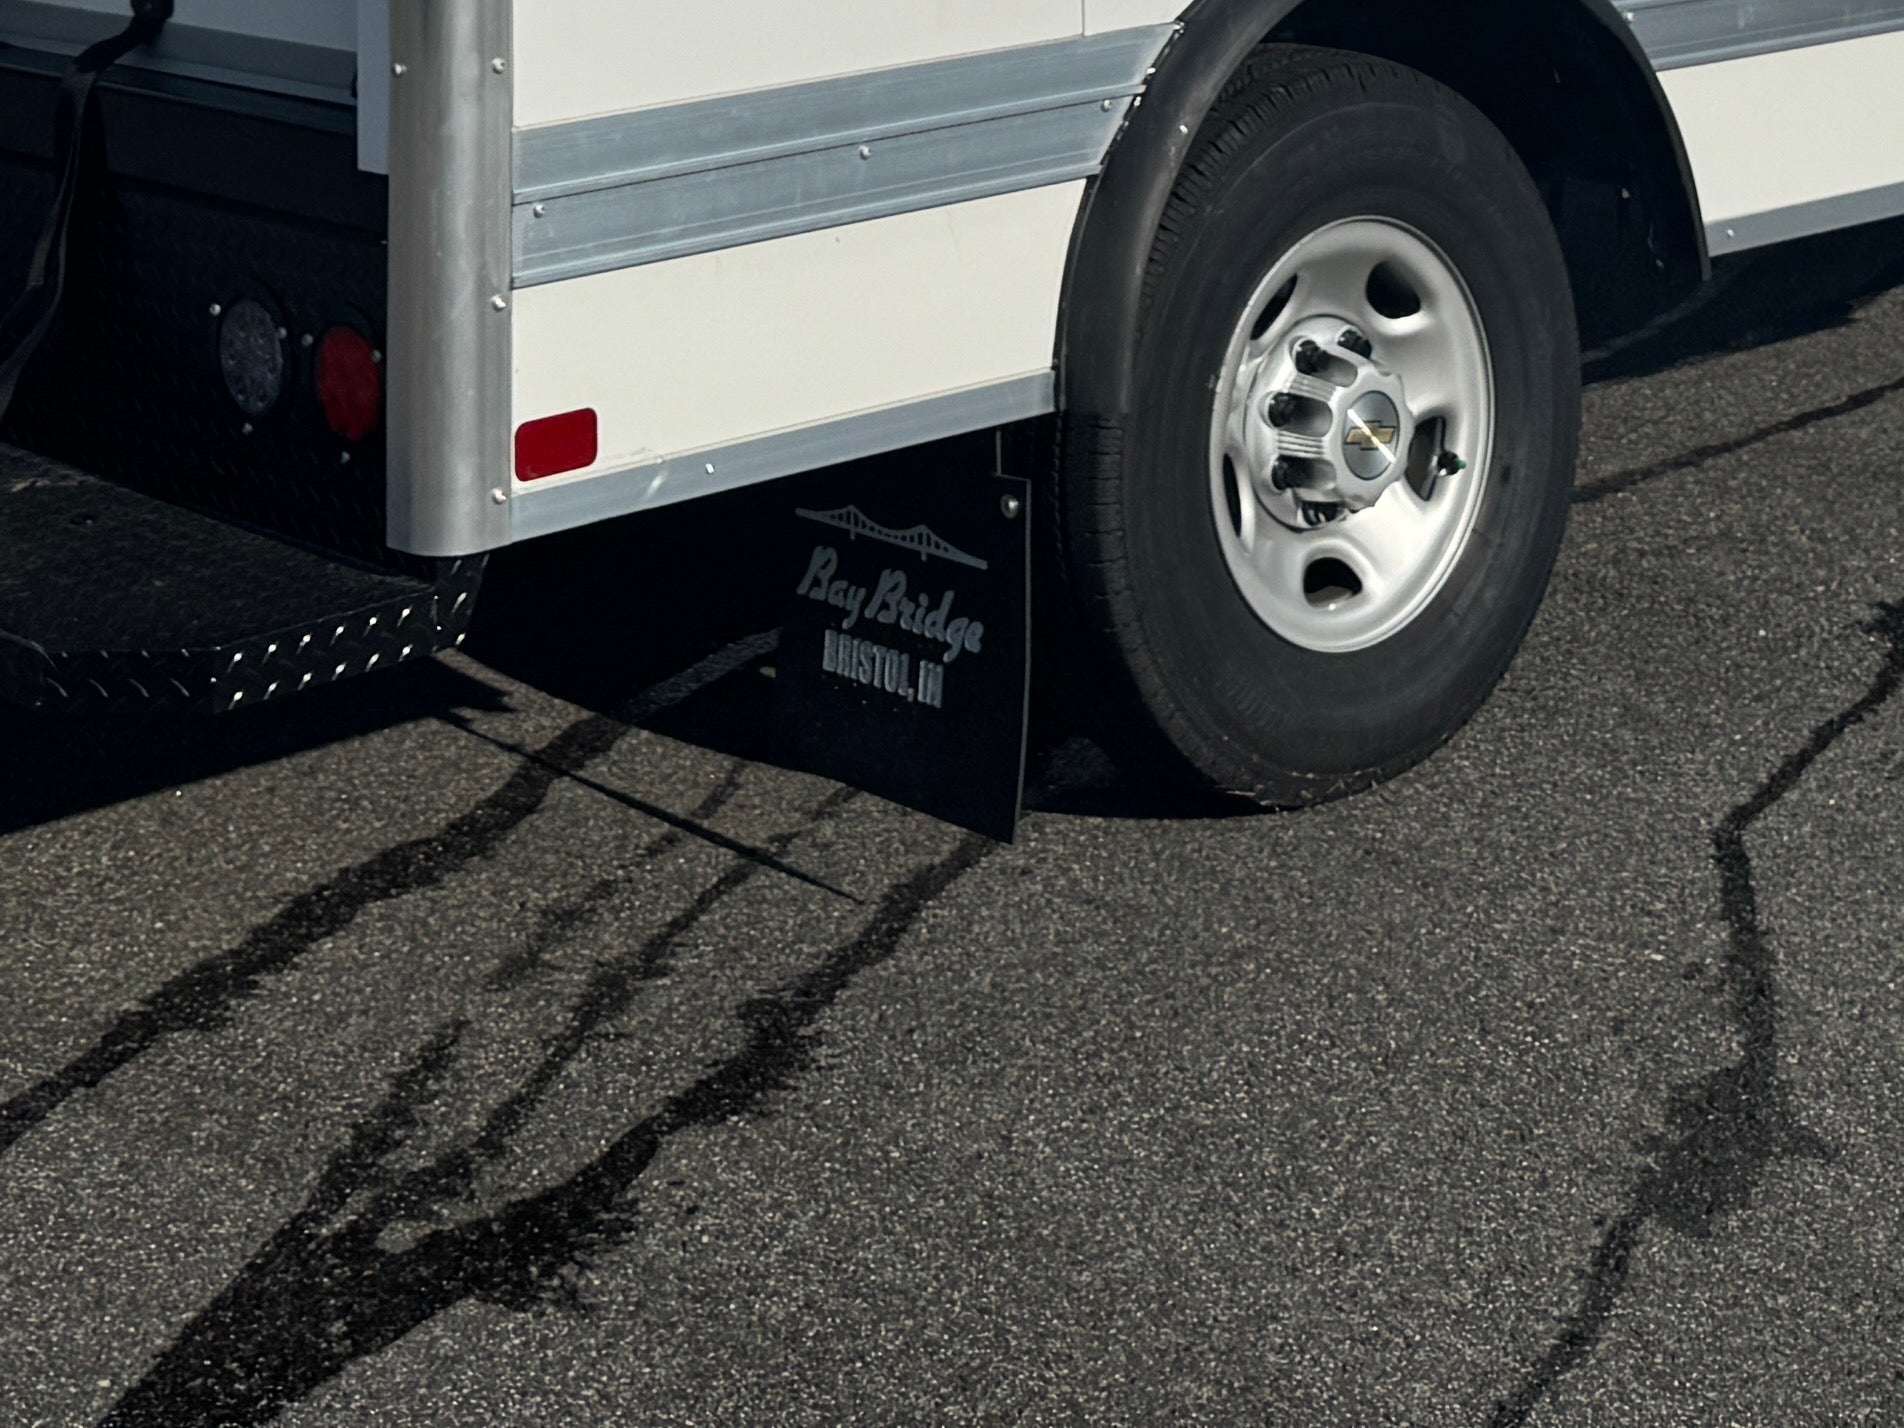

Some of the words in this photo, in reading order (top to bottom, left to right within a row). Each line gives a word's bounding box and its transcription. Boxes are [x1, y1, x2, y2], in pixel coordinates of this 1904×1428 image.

[796, 545, 866, 630] Bay
[864, 569, 985, 663] Bridge
[822, 629, 915, 702] BRISTOL,
[917, 660, 944, 708] IN
